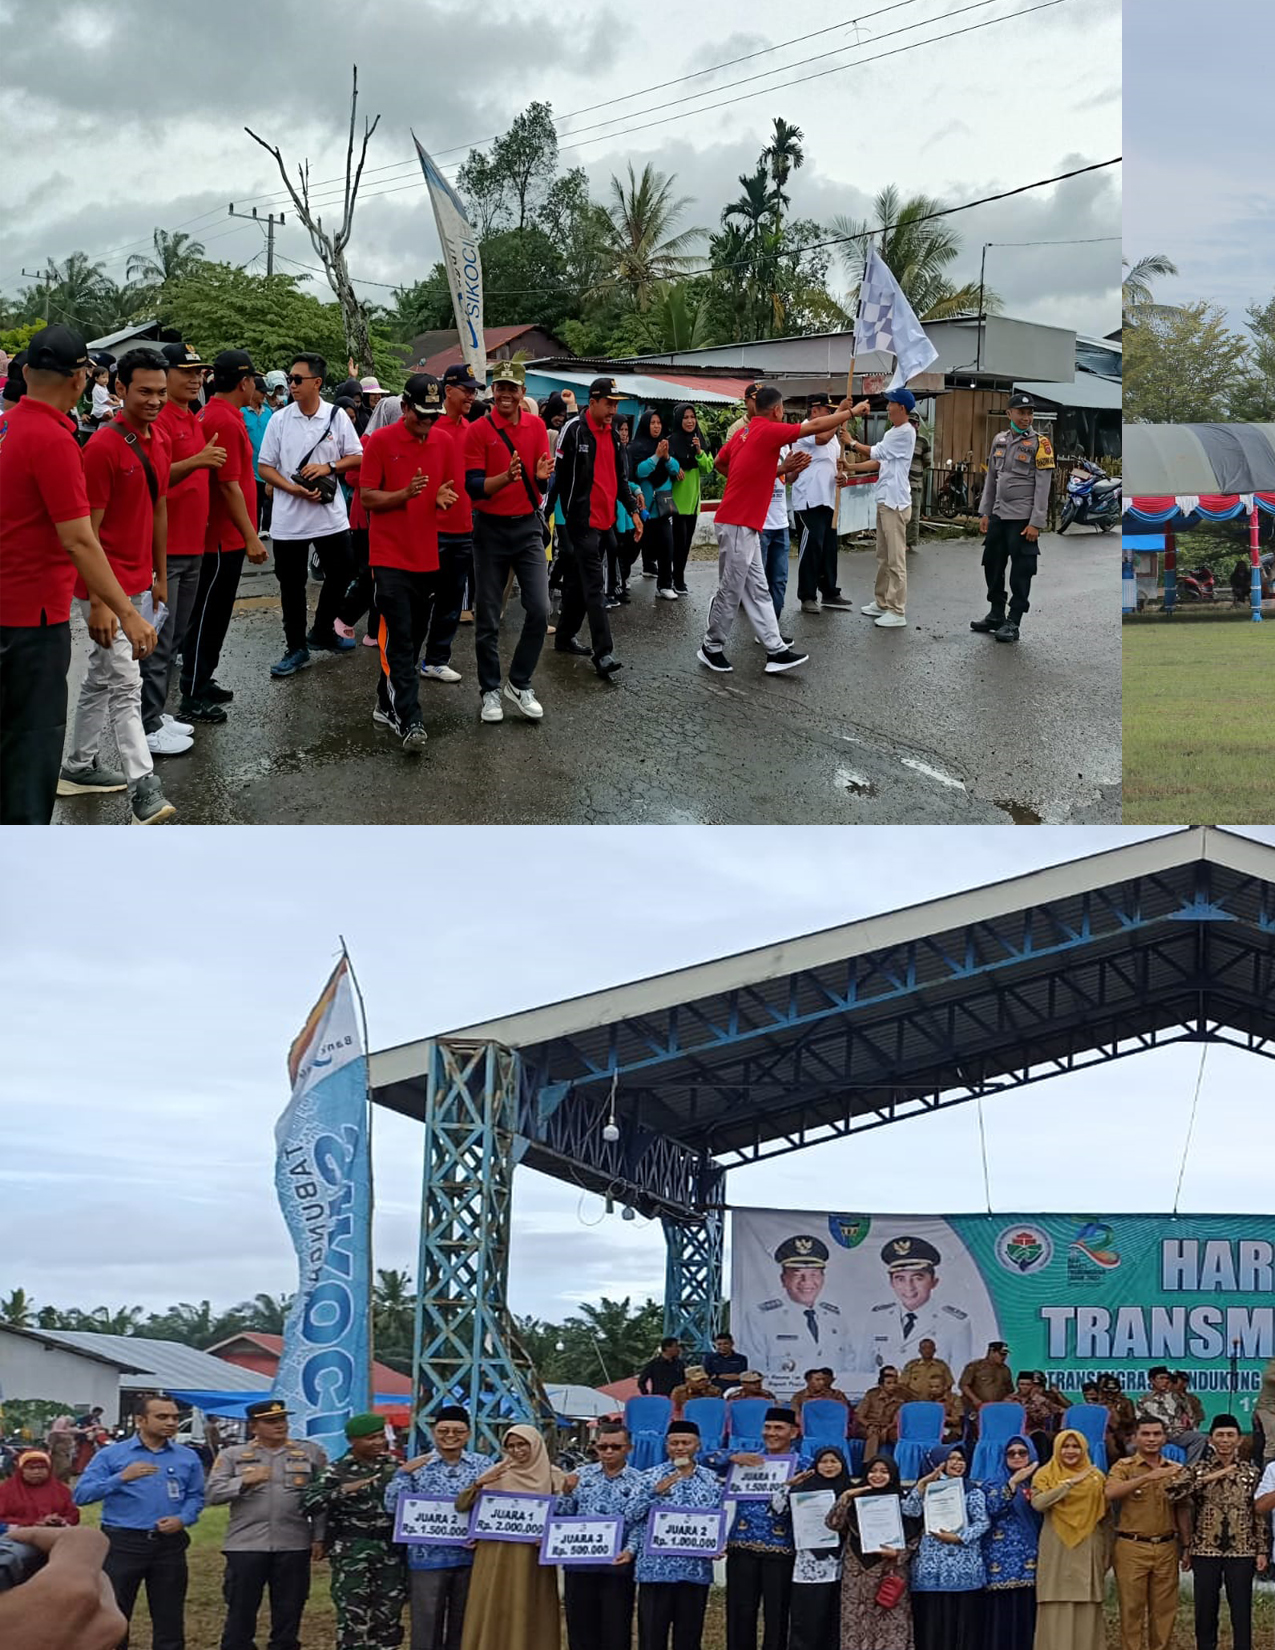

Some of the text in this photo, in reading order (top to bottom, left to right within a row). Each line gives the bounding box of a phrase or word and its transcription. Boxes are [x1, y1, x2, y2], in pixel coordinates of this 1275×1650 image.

[741, 1471, 770, 1482] JUARA
[415, 1512, 459, 1526] JUARA 2
[490, 1508, 534, 1522] JUARA 1
[401, 1522, 468, 1538] Rp. 1.500.000
[476, 1518, 544, 1534] Rp. 2.000.000
[665, 1523, 708, 1537] JUARA 2
[560, 1532, 595, 1545] JUARA
[652, 1535, 717, 1549] Rp. 1.000.000
[551, 1543, 609, 1557] Rp. 500.000
